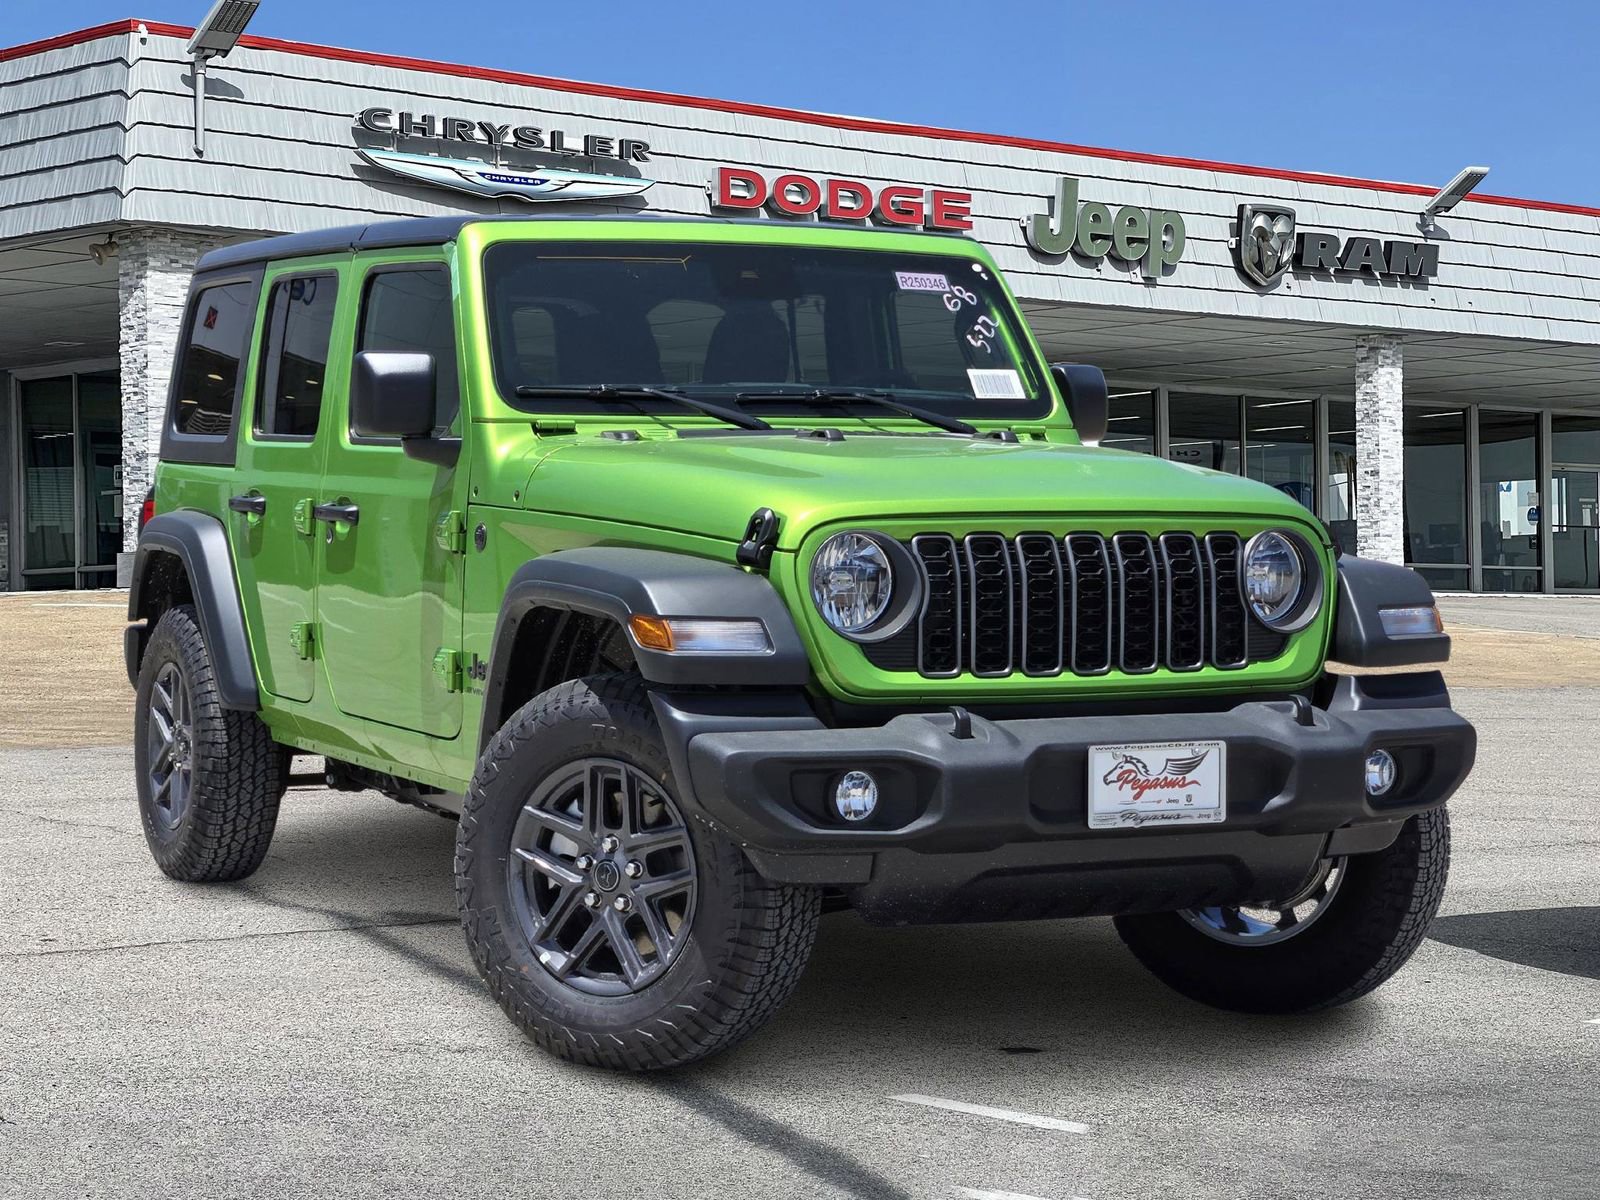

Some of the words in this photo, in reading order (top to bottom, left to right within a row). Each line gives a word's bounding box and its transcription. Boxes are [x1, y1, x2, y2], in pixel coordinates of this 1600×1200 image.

[359, 107, 651, 162] CHRYSLER
[484, 174, 541, 184] CHRYSLER
[713, 166, 973, 231] DODGE
[1027, 177, 1186, 278] Jeep
[1296, 232, 1440, 278] RAM
[900, 276, 947, 290] R250346
[1117, 768, 1201, 801] Pegasus
[1120, 812, 1194, 824] Pegasus
